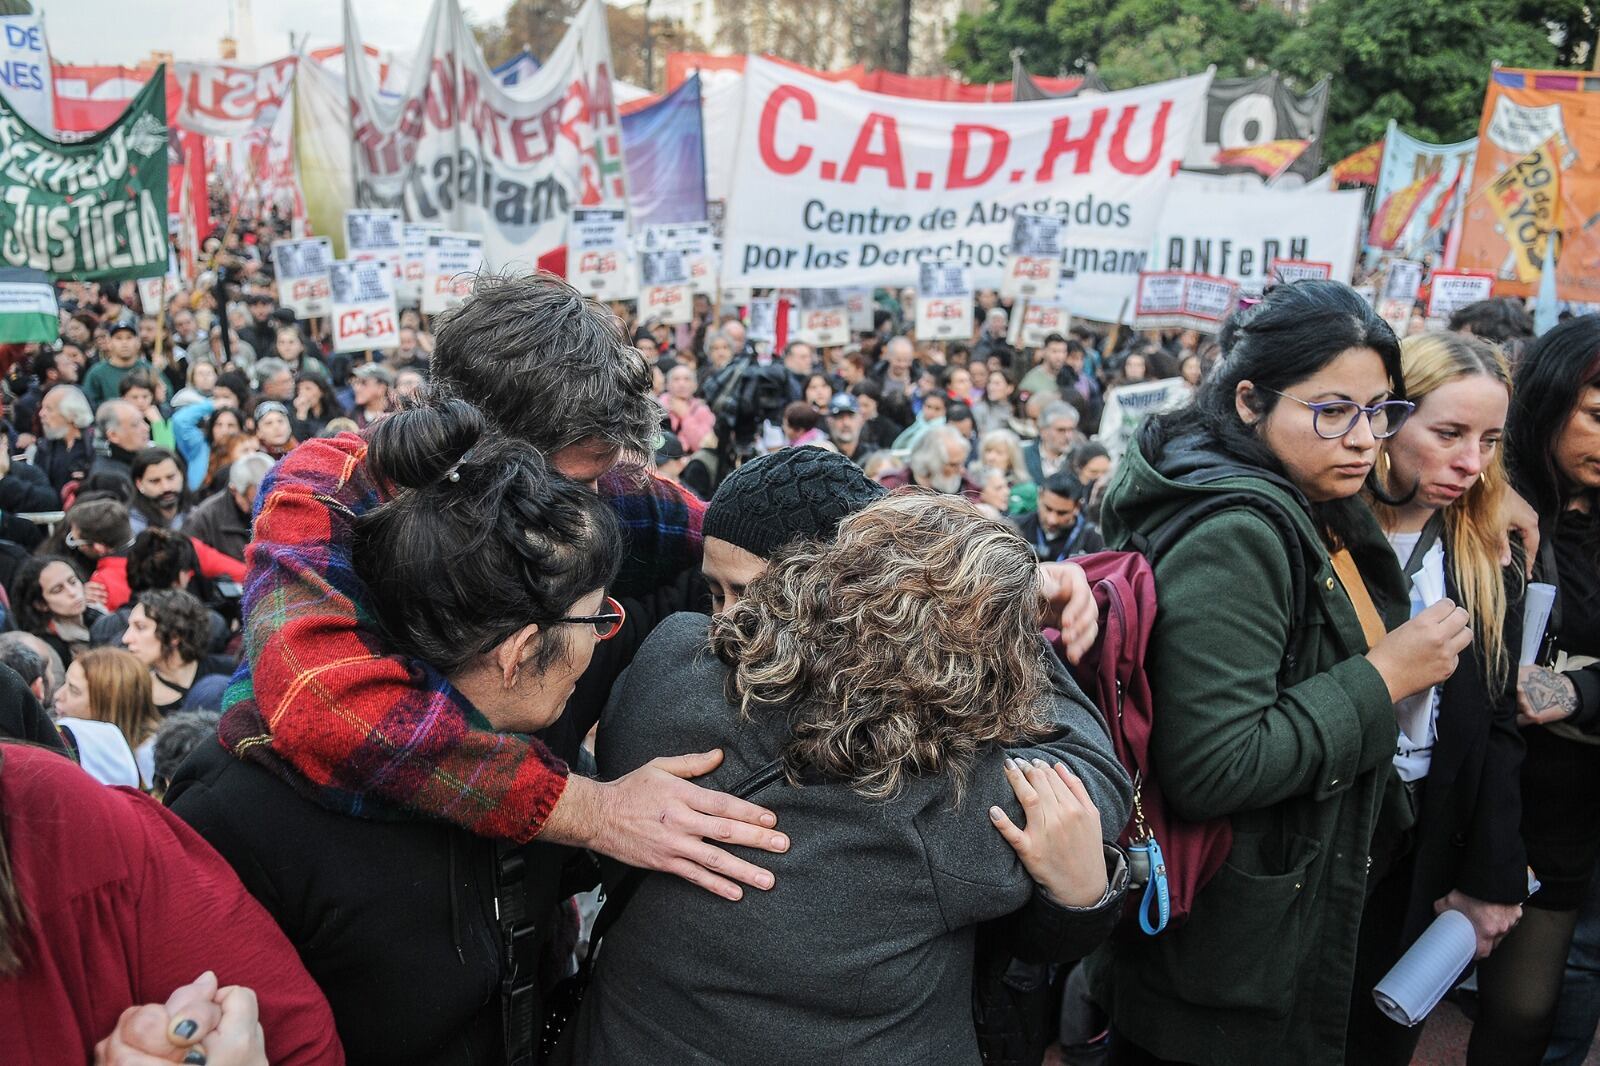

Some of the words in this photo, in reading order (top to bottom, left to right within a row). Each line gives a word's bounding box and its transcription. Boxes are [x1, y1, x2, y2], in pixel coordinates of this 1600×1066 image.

[6, 24, 42, 51] DE
[1516, 152, 1551, 188] 29
[803, 199, 911, 235] Centro
[920, 206, 957, 232] de
[742, 243, 798, 275] por
[803, 242, 849, 270] los
